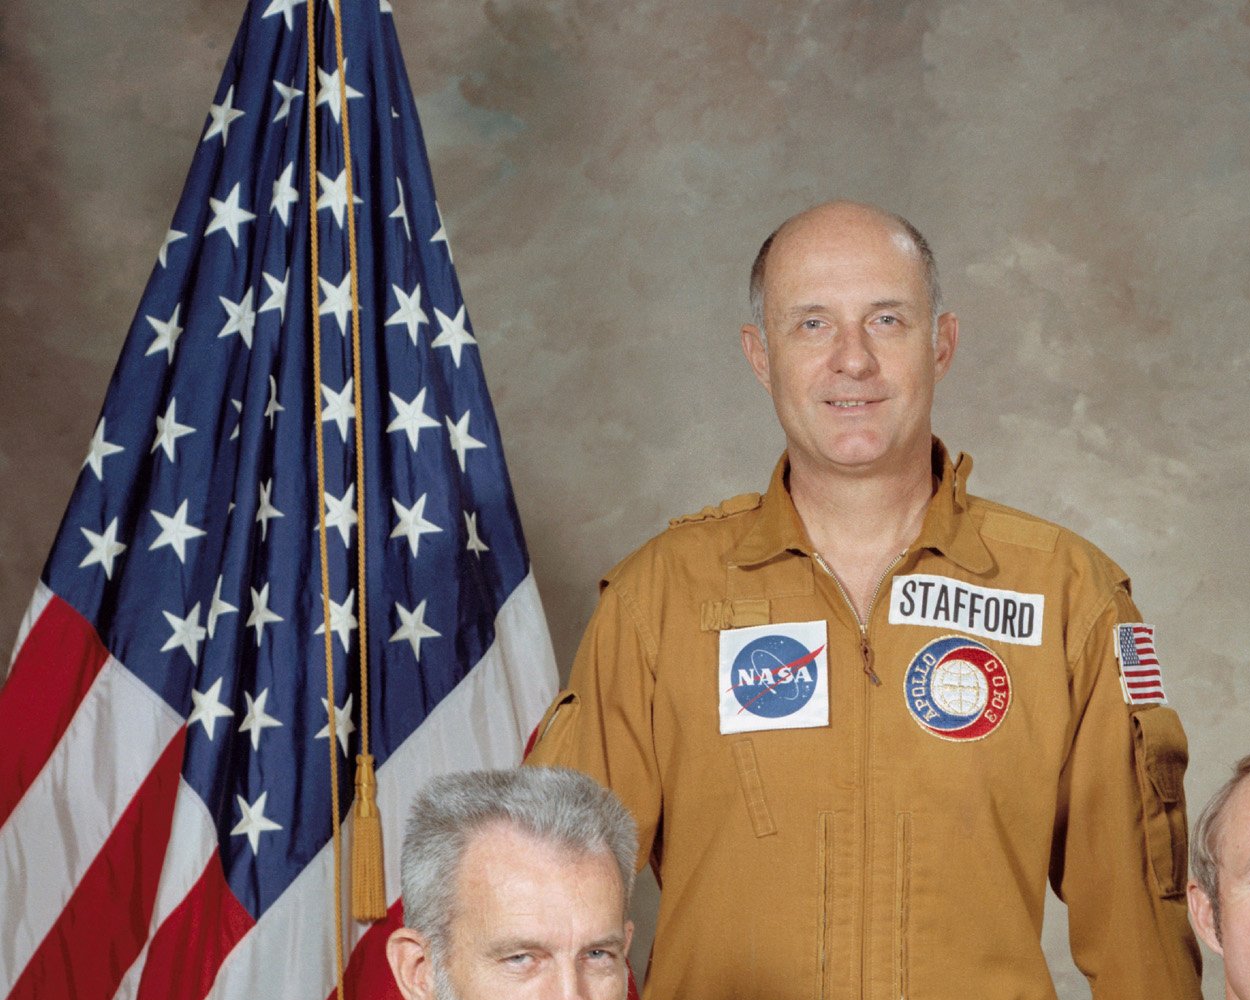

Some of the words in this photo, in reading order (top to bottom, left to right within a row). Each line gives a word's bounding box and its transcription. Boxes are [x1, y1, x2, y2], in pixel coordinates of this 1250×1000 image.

[900, 580, 1035, 638] STAFFORD
[737, 665, 814, 687] NASA
[912, 653, 941, 722] APOLLO
[984, 660, 1007, 723] СОЮЗ
